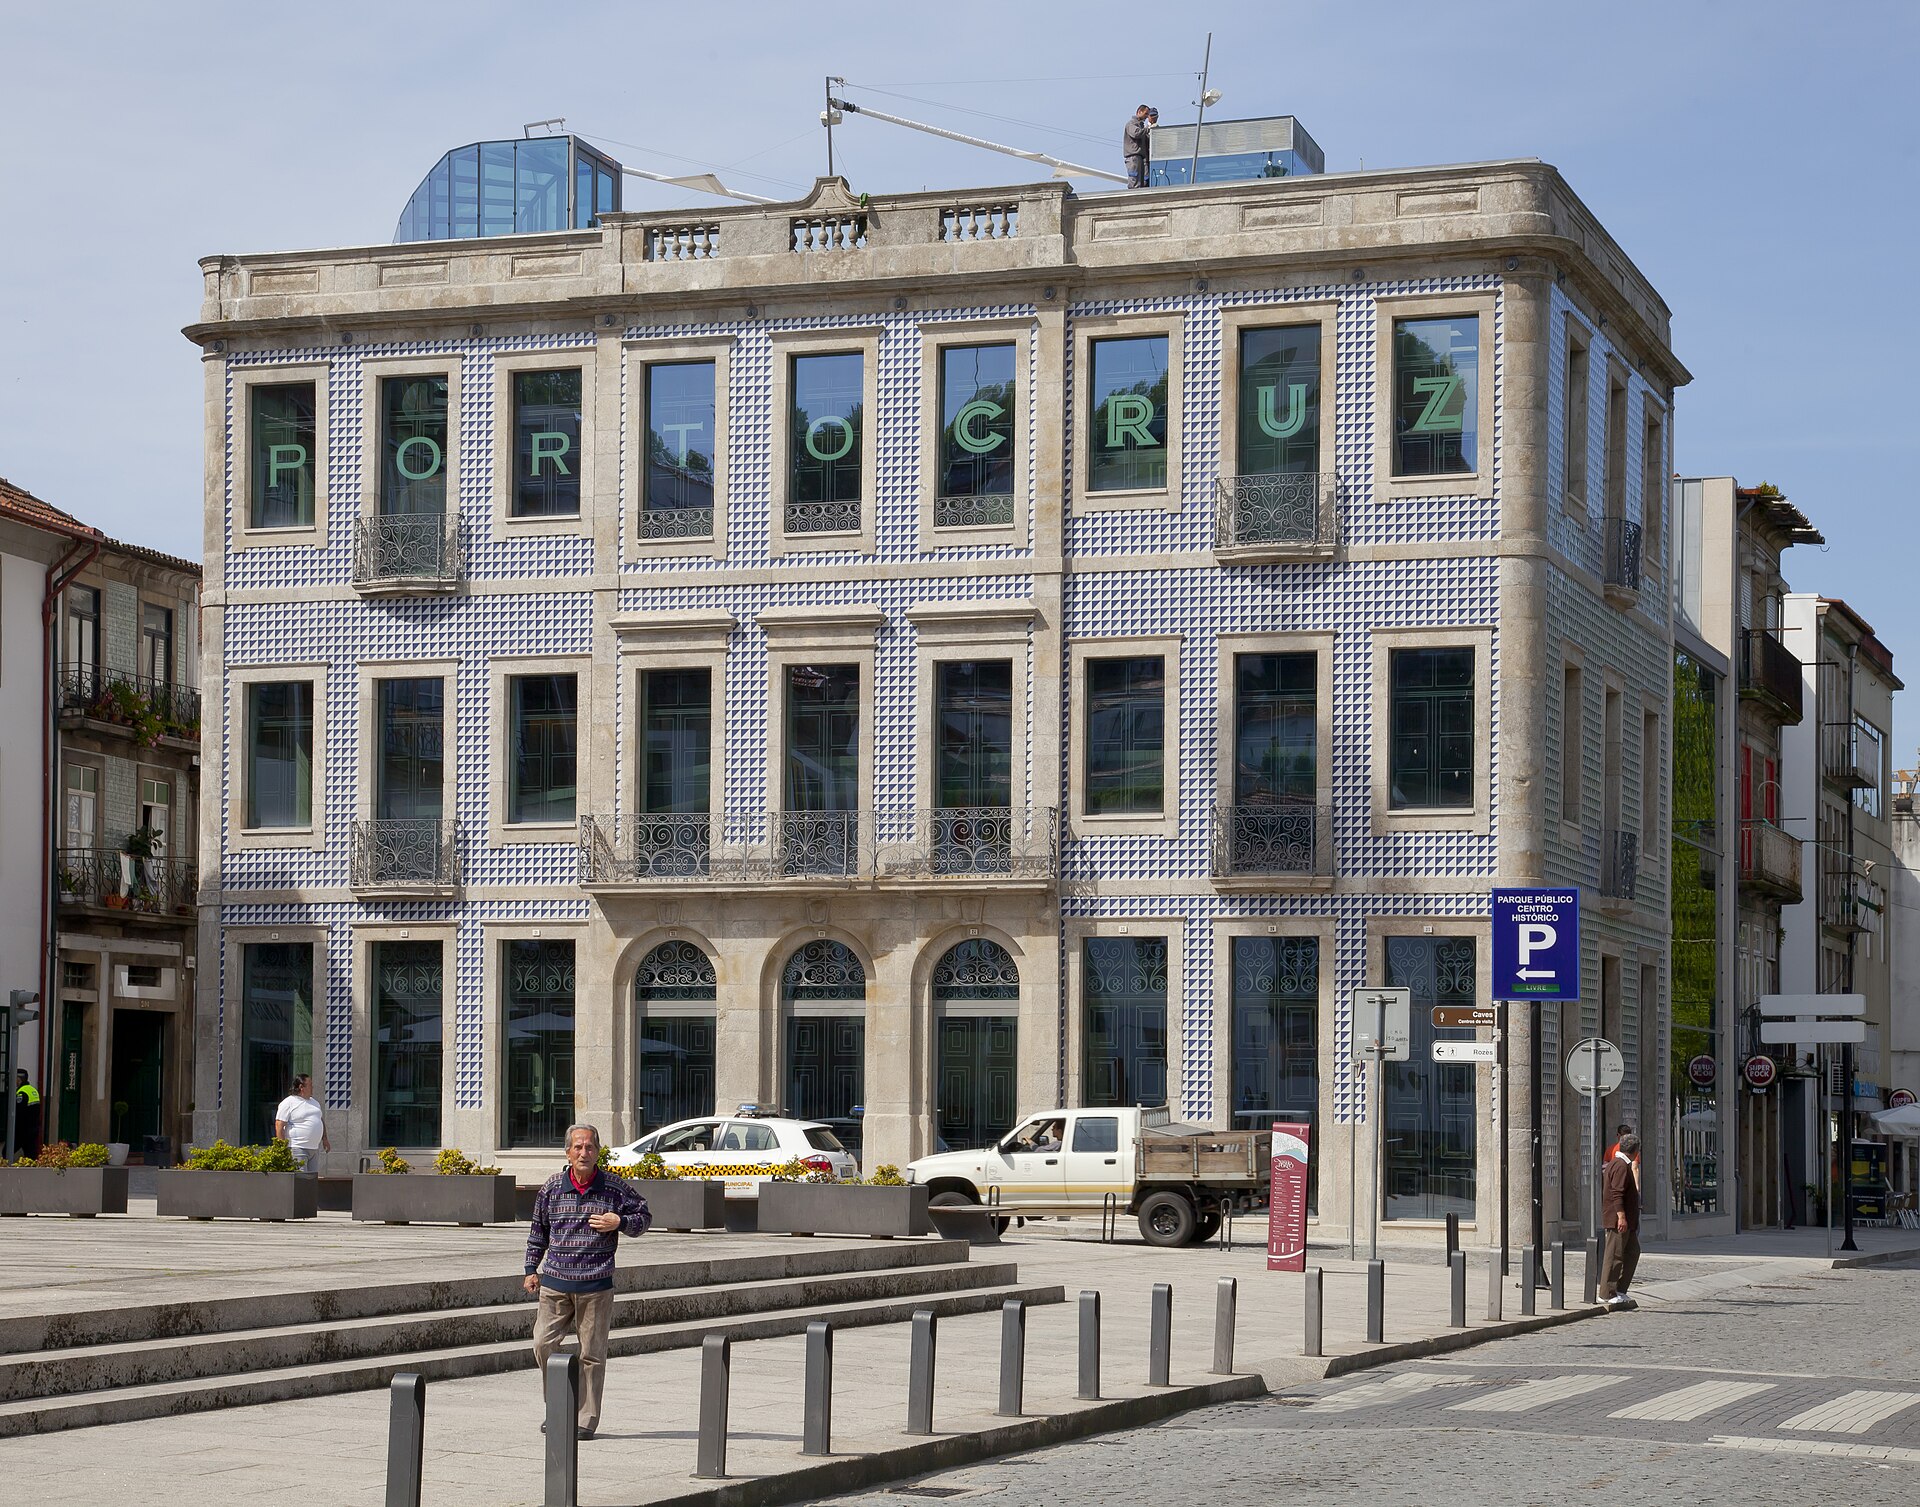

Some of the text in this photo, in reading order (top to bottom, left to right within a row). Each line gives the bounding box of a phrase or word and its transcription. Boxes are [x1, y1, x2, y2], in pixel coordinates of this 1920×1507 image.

[1497, 894, 1573, 904] PARQUE PÚBLICO
[1517, 905, 1553, 913] CENTRO
[1511, 913, 1559, 922] HISTÓRICO
[1518, 923, 1557, 965] P
